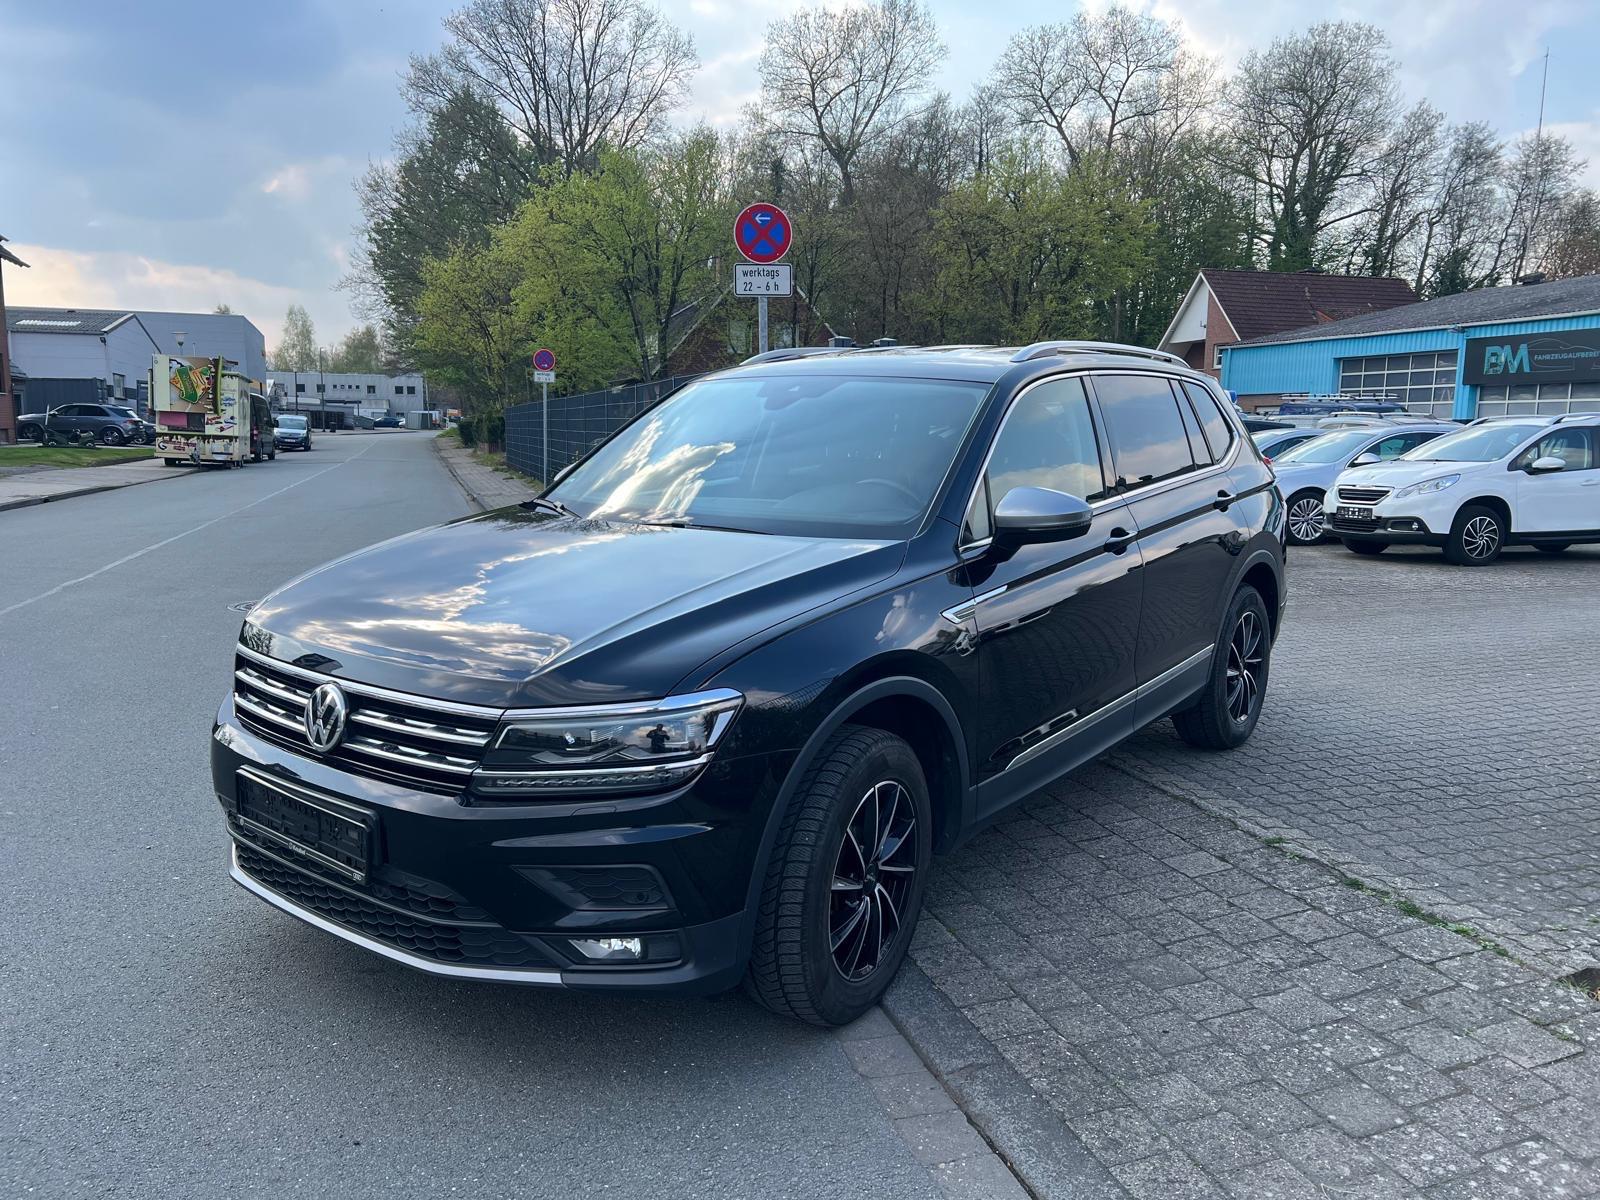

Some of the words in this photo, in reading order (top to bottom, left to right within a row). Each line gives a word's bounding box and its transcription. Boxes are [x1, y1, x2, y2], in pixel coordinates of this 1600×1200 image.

[742, 267, 780, 280] werktags
[743, 281, 753, 292] 22
[765, 281, 771, 292] 6
[774, 281, 779, 292] h
[1483, 344, 1531, 375] BM
[305, 684, 345, 750] VW
